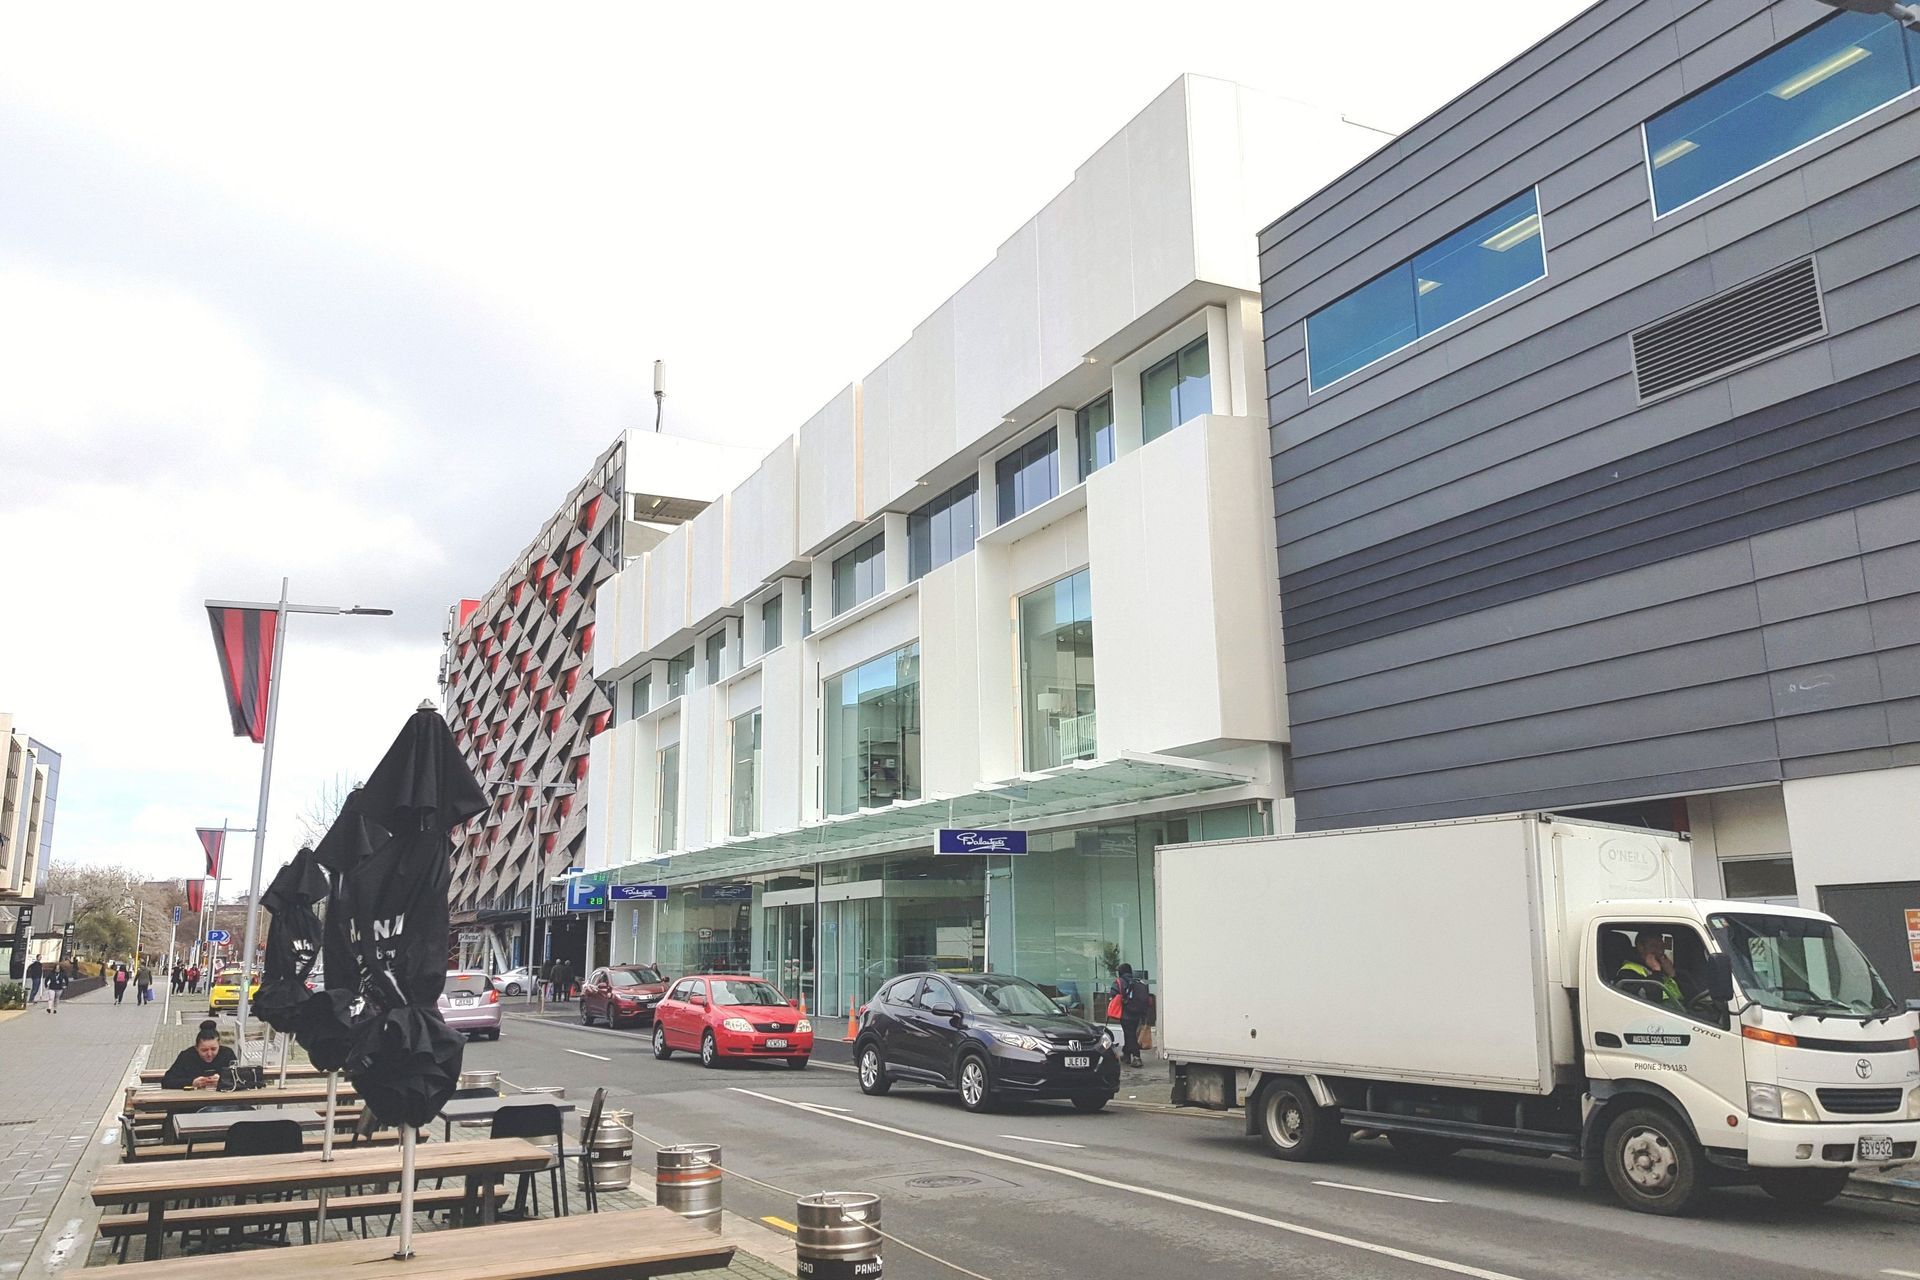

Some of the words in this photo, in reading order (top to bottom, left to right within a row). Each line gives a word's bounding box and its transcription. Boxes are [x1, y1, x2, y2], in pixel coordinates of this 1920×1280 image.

[1692, 1026, 1722, 1040] DYNA
[1650, 1035, 1663, 1044] COOL
[1663, 1036, 1682, 1045] STORES
[1634, 1062, 1656, 1071] PHONE
